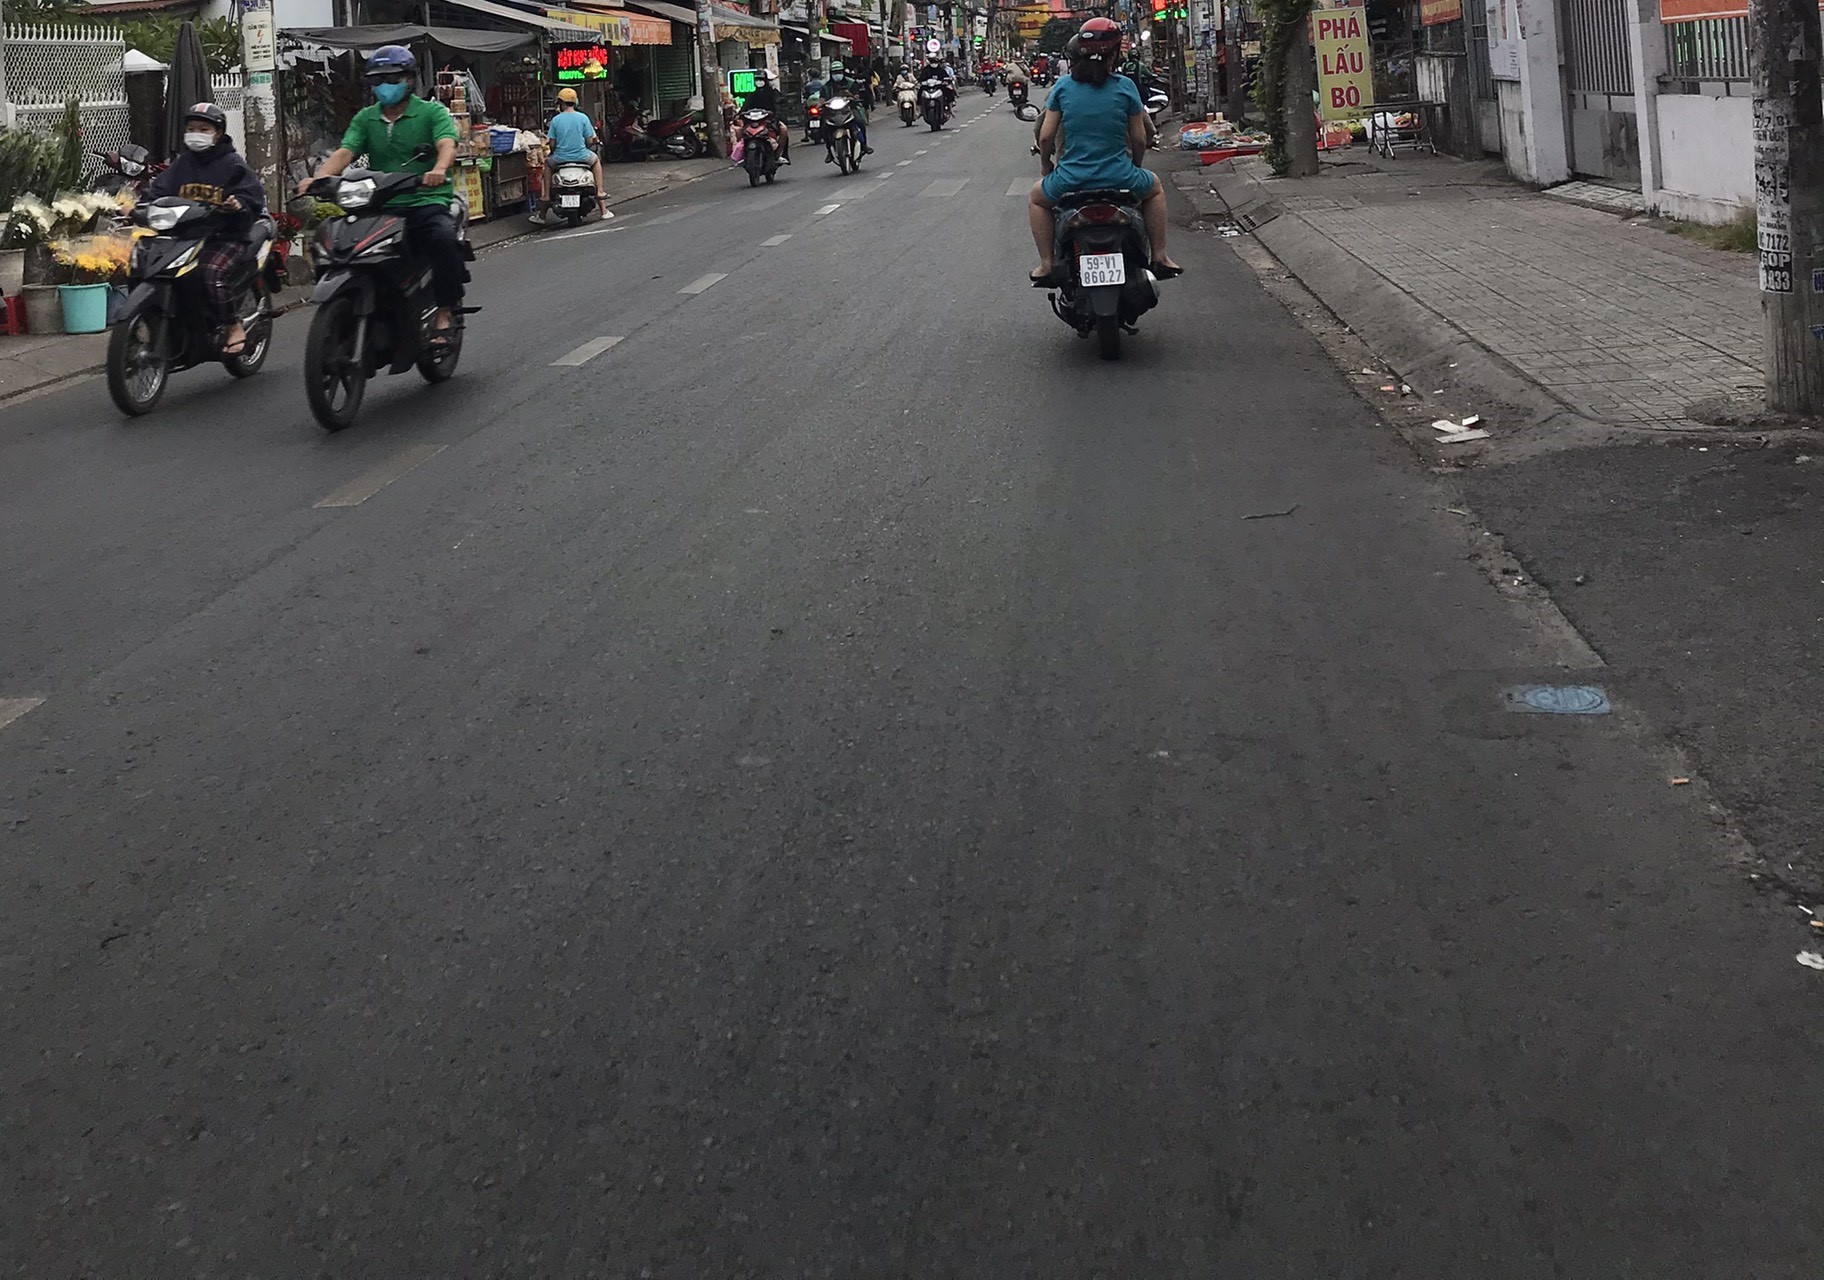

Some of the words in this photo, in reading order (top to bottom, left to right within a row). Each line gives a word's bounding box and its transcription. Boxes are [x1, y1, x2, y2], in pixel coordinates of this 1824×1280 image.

[1318, 10, 1362, 40] PHÁ
[1322, 43, 1365, 75] LẤU
[1330, 80, 1361, 109] BÒ
[1084, 270, 1122, 284] 860.27
[1086, 257, 1116, 270] 59-V1
